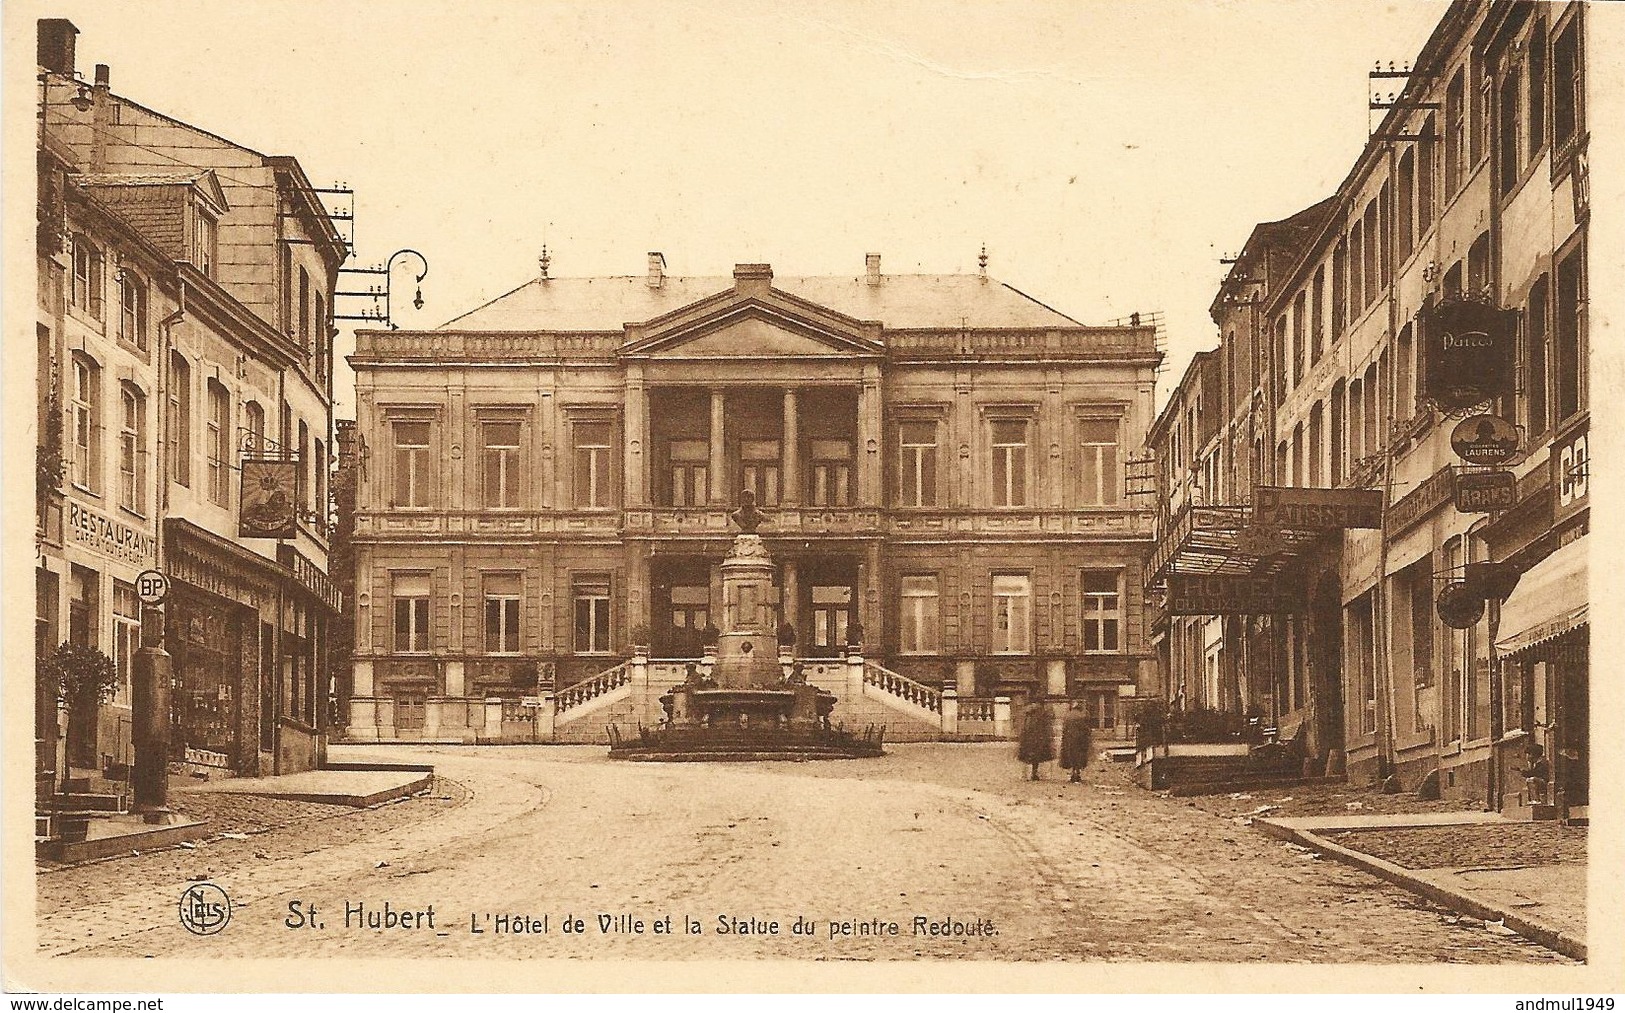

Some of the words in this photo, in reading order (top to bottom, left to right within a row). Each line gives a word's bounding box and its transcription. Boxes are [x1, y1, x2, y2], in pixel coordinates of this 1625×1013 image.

[1465, 448, 1506, 457] LAURENS
[69, 502, 155, 558] RESTAURANT
[140, 578, 163, 597] BP
